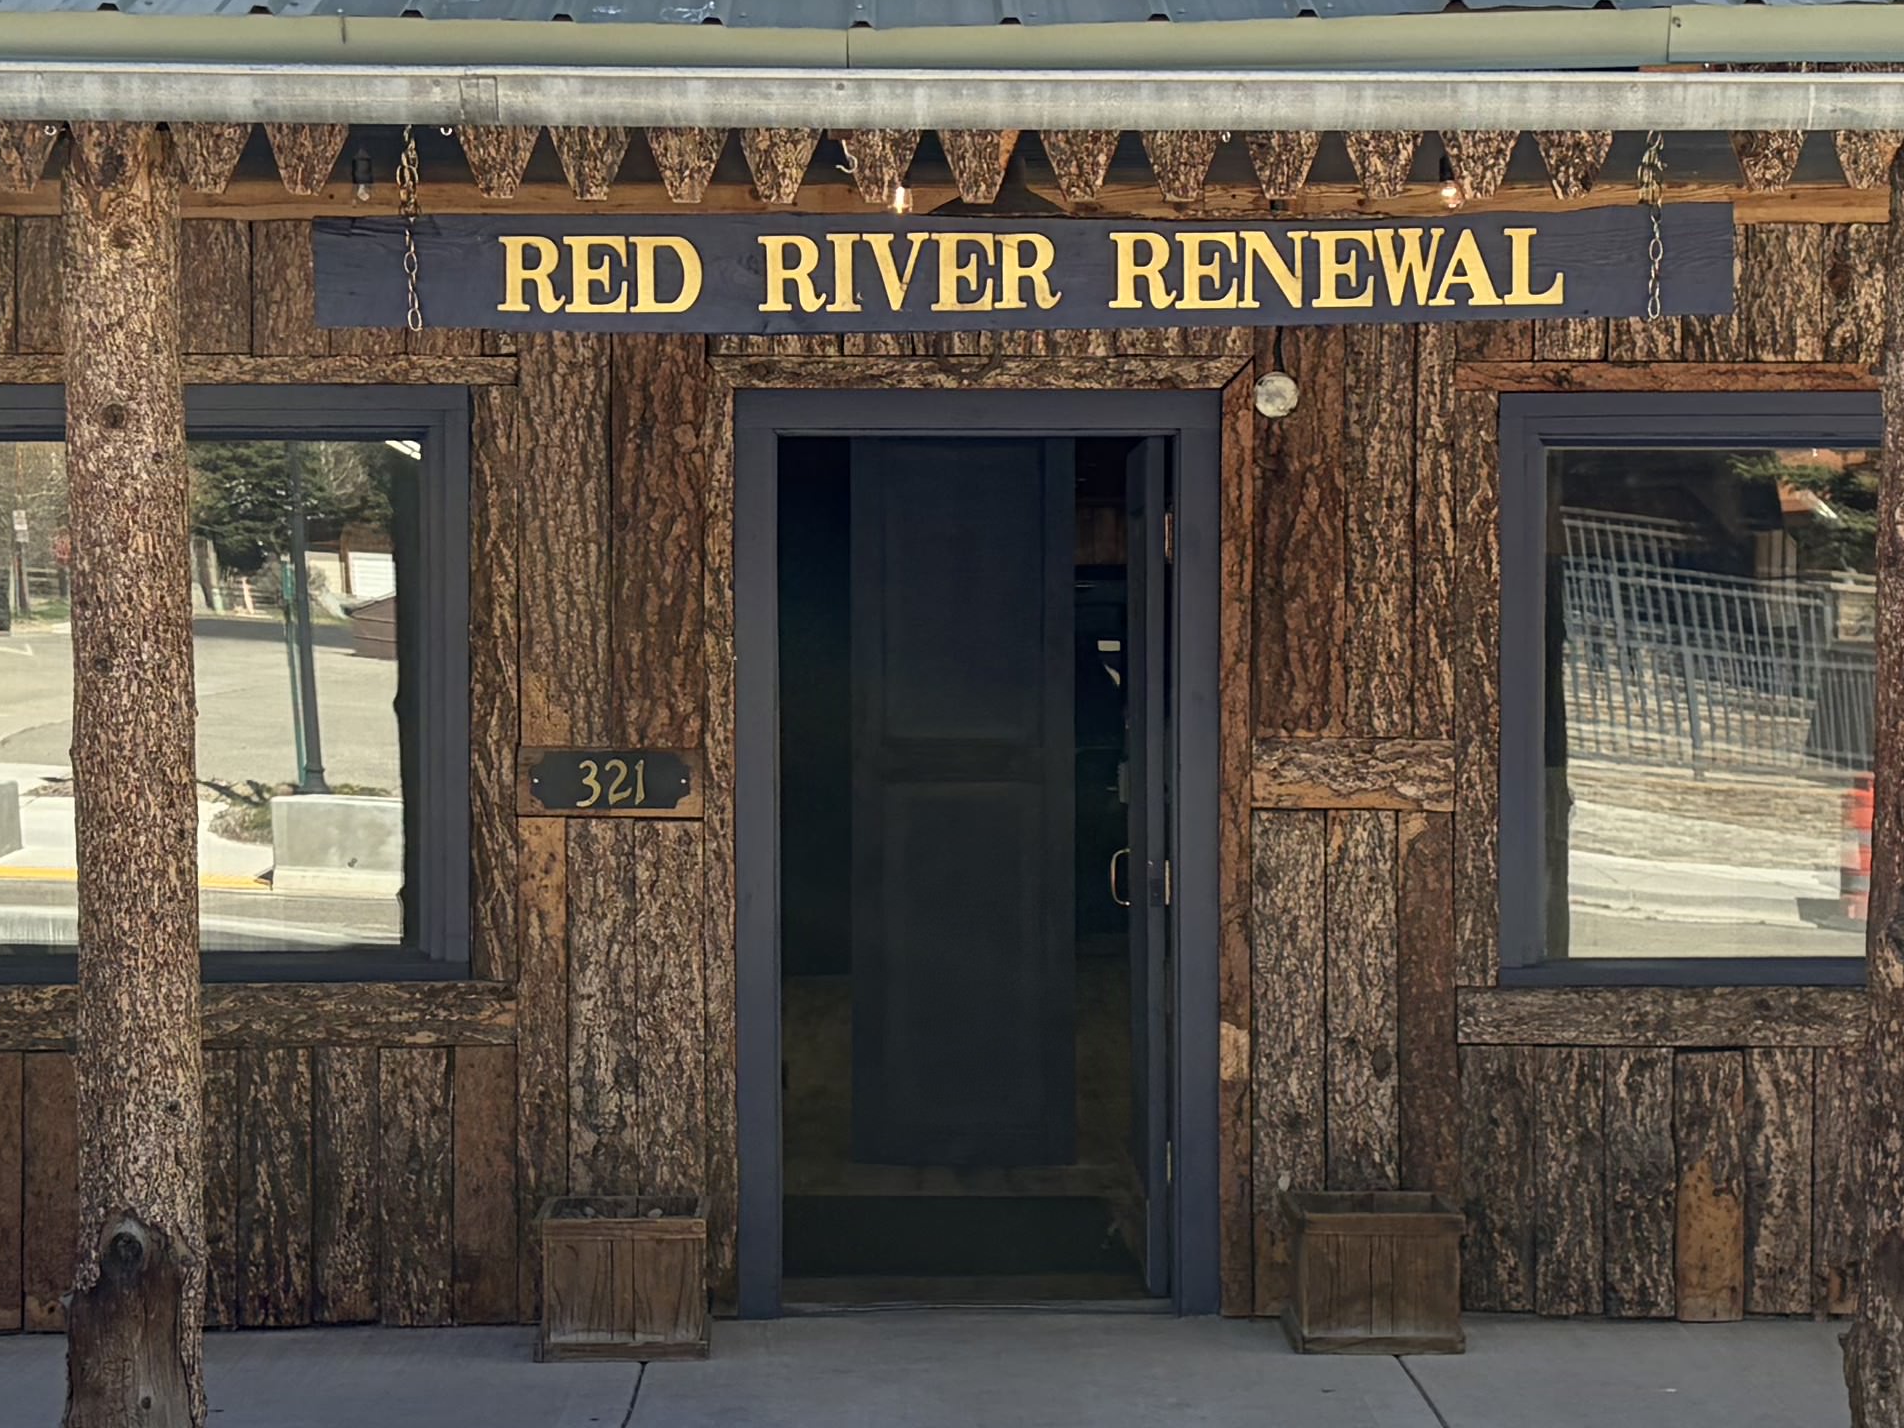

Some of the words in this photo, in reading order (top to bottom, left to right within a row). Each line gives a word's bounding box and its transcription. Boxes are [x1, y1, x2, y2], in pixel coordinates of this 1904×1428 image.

[497, 234, 703, 314] RED
[757, 232, 1062, 314] RIVER
[1108, 226, 1566, 310] RENEWAL
[575, 758, 646, 809] 321
